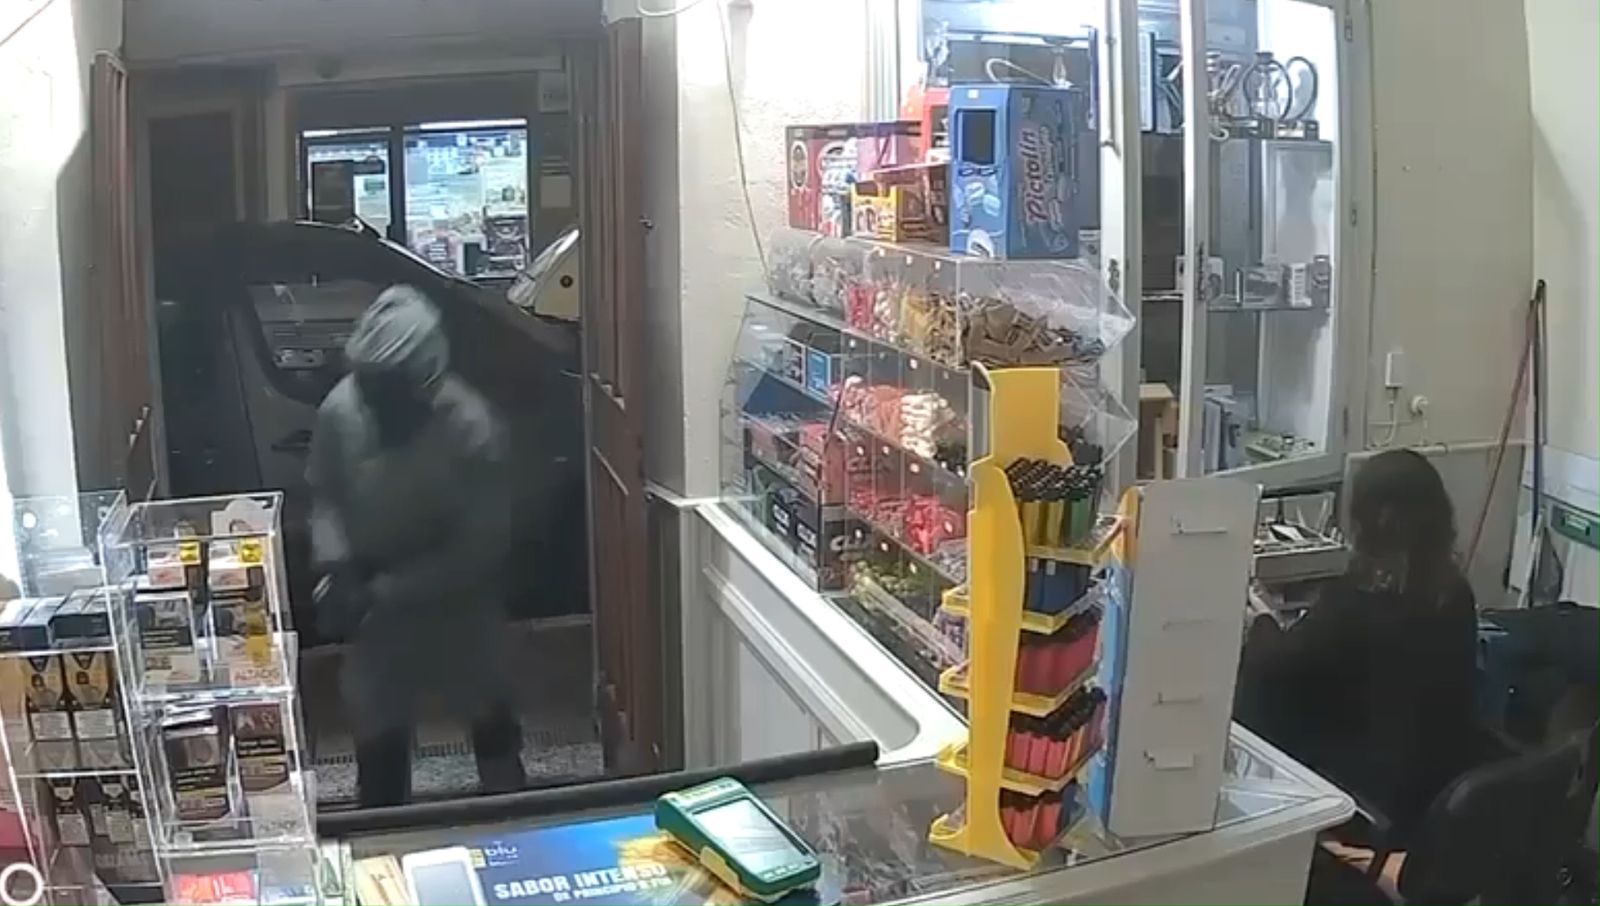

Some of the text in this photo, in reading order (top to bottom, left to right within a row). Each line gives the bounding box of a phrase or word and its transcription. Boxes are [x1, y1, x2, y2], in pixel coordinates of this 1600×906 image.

[1019, 131, 1047, 223] Pictolin
[494, 863, 668, 900] SABOR INTENSO
